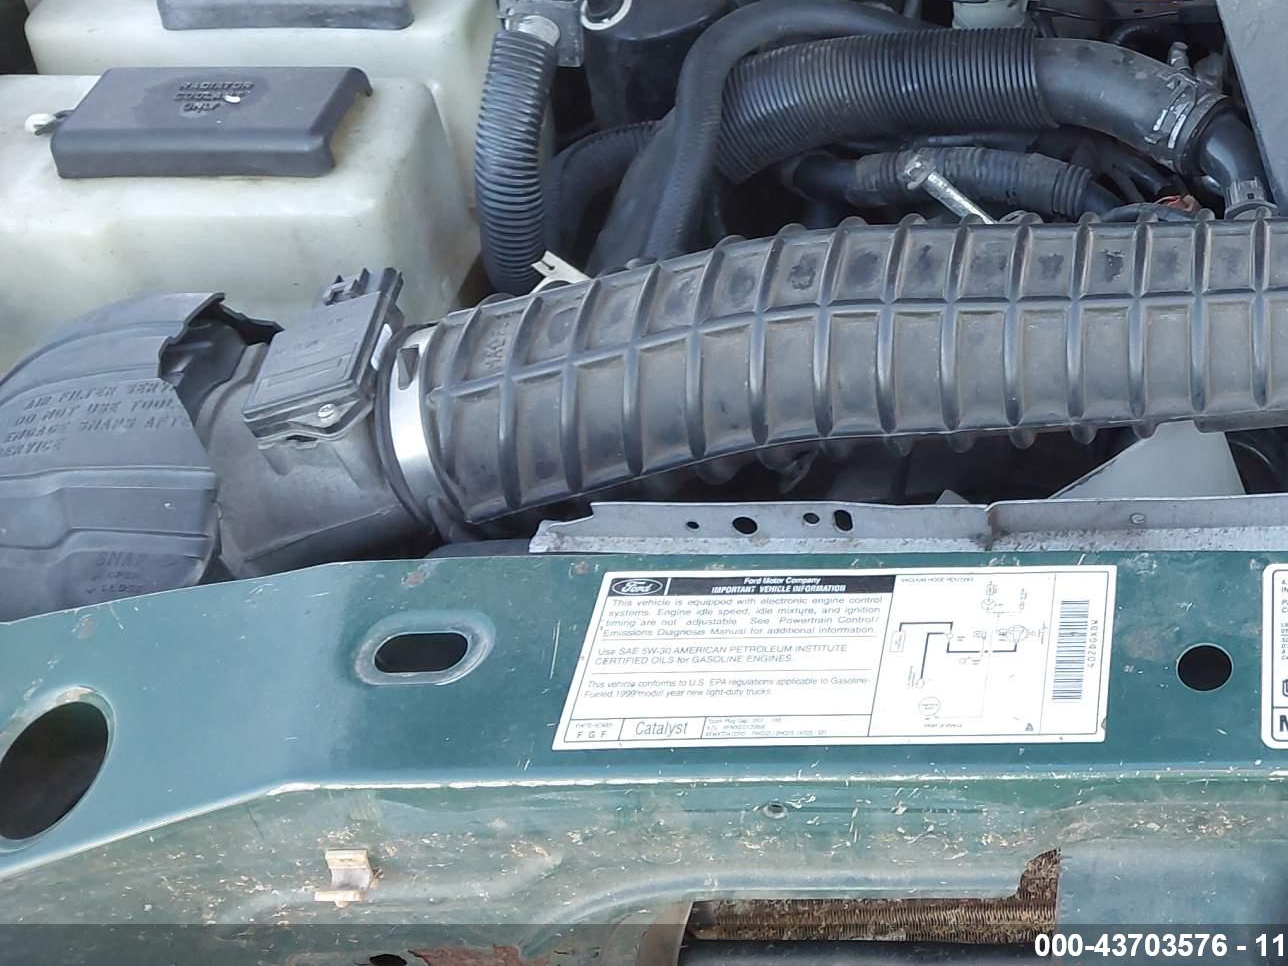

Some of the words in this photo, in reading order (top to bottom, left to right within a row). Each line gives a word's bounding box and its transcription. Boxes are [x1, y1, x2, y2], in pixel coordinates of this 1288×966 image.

[786, 577, 821, 585] Company
[712, 585, 755, 594] IMPORTANT
[760, 585, 790, 593] VEHICLE
[688, 598, 733, 607] equipped
[812, 597, 844, 605] engine
[657, 609, 692, 617] Engine
[778, 607, 816, 615] mixture,
[686, 618, 737, 626] adjustable
[779, 616, 832, 624] Powertrain
[603, 629, 652, 637] Emissions
[657, 628, 705, 637] Diagnosis
[641, 647, 671, 655] 5W-30
[673, 646, 727, 654] AMERICAN
[729, 645, 792, 653] PETROLEUM
[795, 644, 848, 652] INSTITUTE
[594, 657, 648, 665] CERTIFIED
[692, 655, 742, 663] GASOLINE
[746, 654, 792, 662] ENGINES
[710, 678, 726, 686] EPA
[729, 678, 774, 686] regulations
[776, 677, 817, 686] applicable
[706, 689, 743, 697] light-duty
[636, 722, 688, 737] Catalyst
